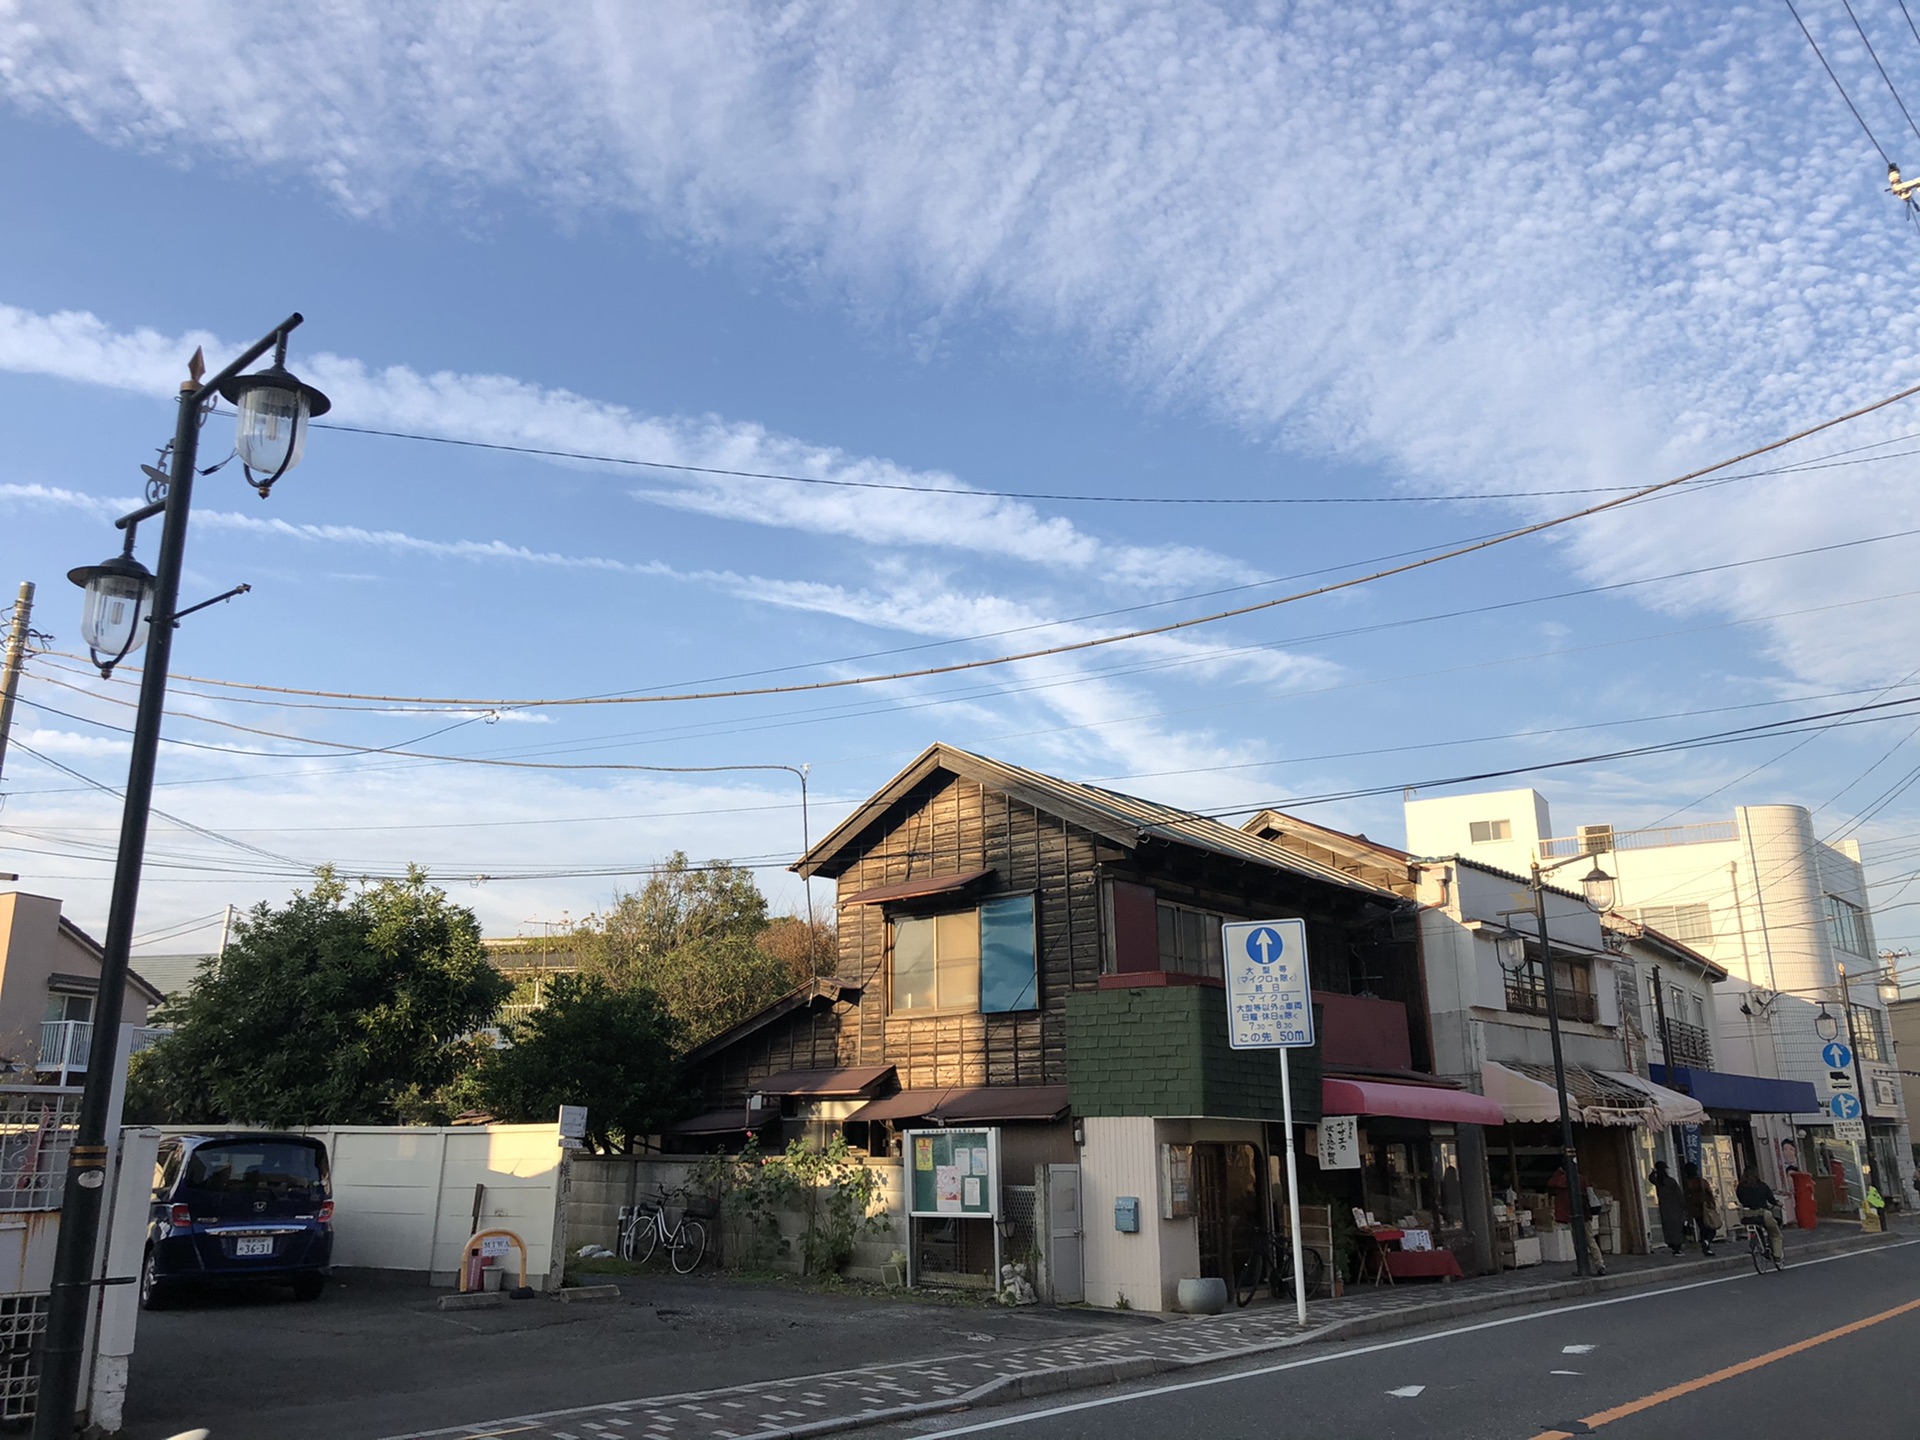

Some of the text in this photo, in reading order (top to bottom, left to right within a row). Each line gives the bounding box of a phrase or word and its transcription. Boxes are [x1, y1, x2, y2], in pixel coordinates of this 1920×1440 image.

[1248, 994, 1290, 1002] マイクロ
[1236, 1001, 1302, 1013] 大型等以外の車両
[1240, 1029, 1305, 1042] この先 50m
[1336, 1121, 1347, 1151] サザエの
[484, 1240, 510, 1249] MIWA
